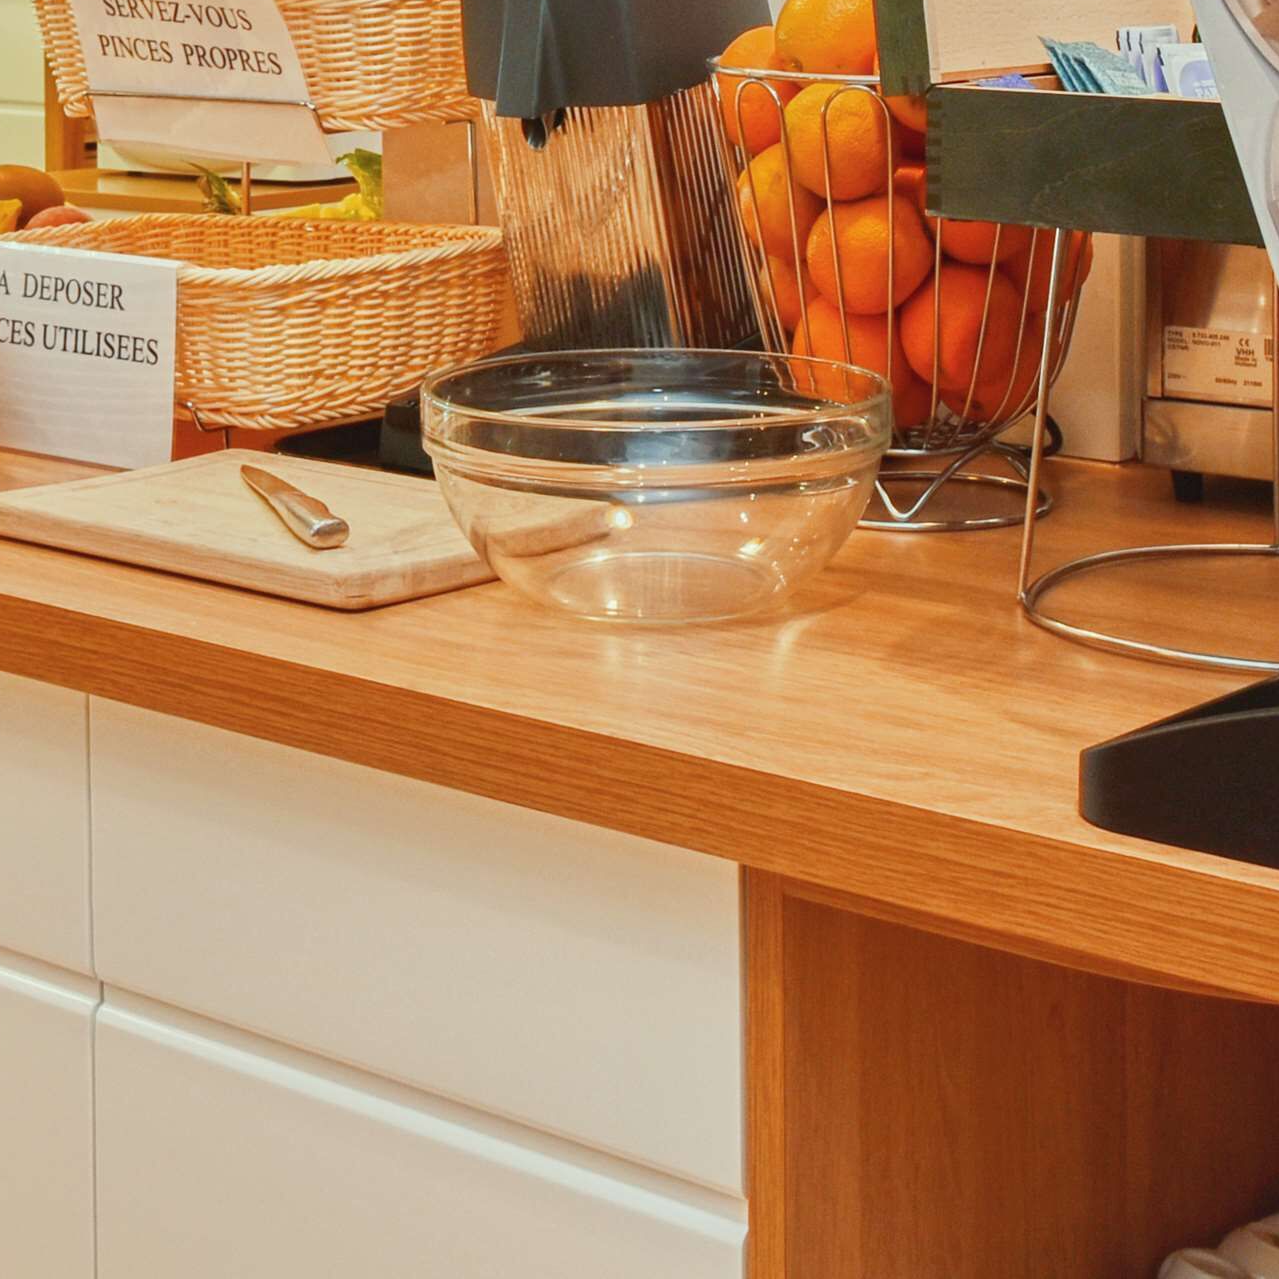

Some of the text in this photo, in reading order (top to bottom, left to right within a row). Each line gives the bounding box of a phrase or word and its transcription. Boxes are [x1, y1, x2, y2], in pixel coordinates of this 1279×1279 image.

[97, 34, 283, 76] PINCES PROPRES
[22, 273, 125, 311] DEPOSER
[43, 324, 159, 366] UTILISEES
